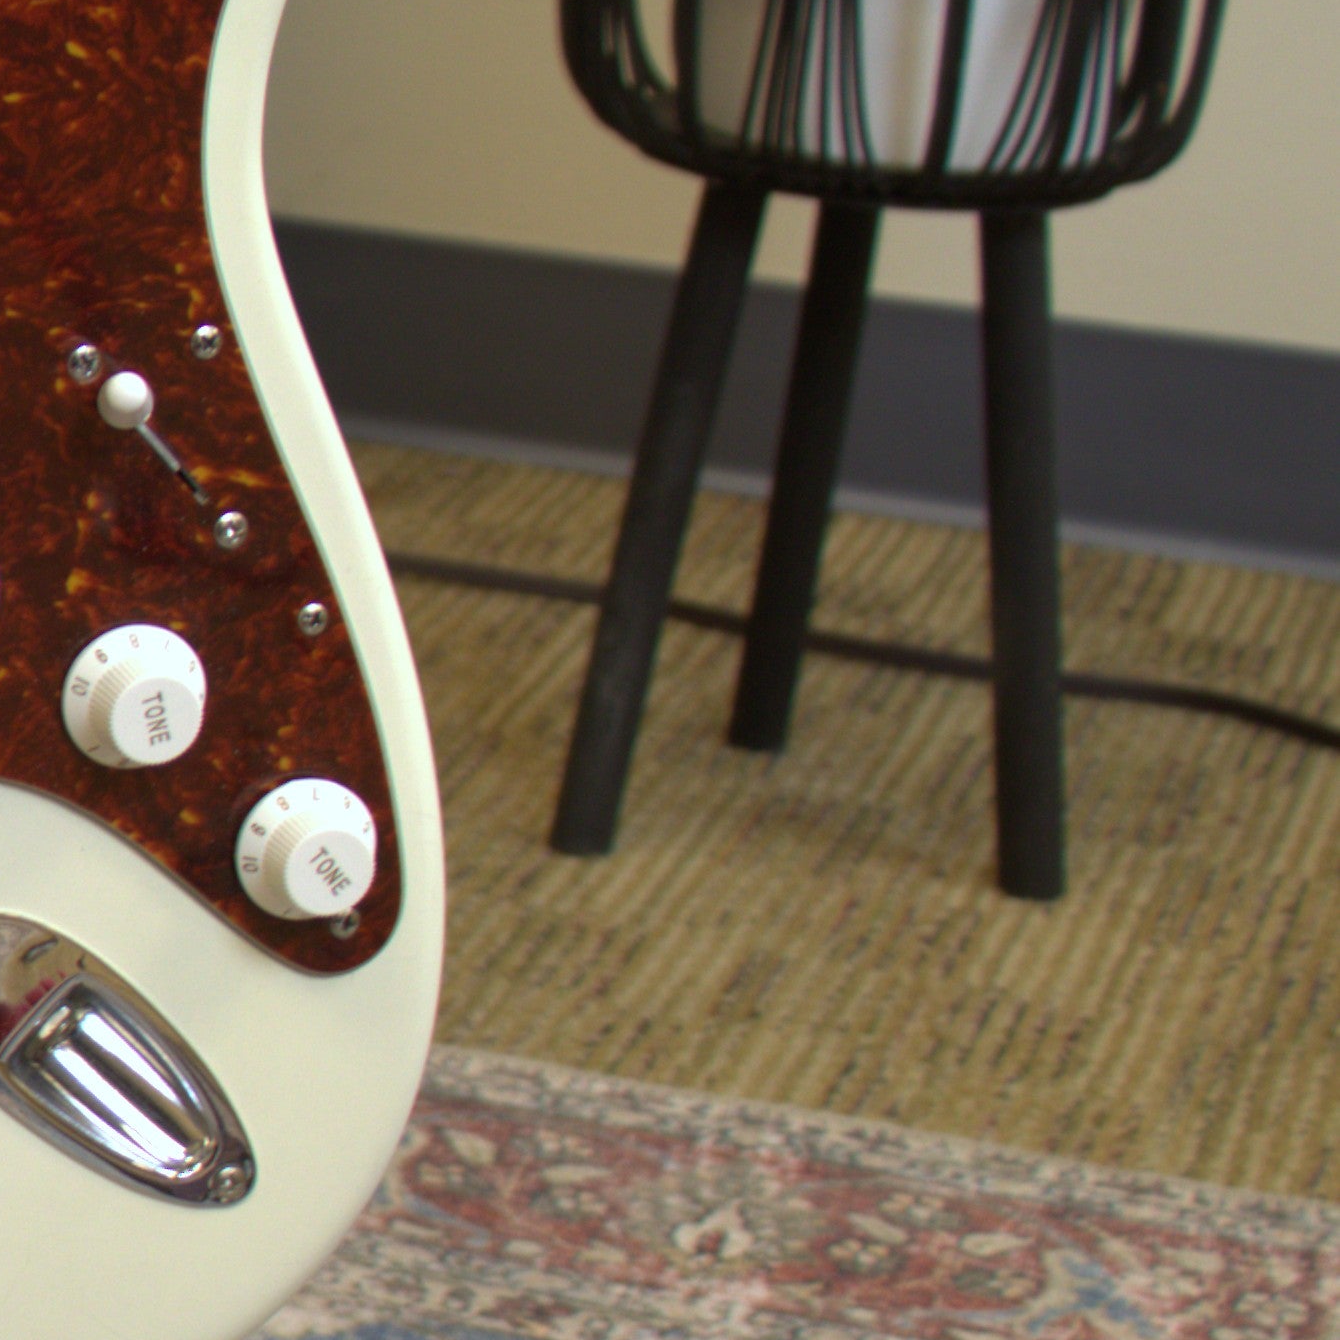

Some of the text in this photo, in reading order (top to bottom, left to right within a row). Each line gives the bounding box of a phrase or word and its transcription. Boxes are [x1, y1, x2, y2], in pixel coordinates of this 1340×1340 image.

[70, 675, 90, 697] 10
[141, 691, 171, 746] TONE
[241, 855, 259, 874] 10
[309, 846, 352, 897] TONE
